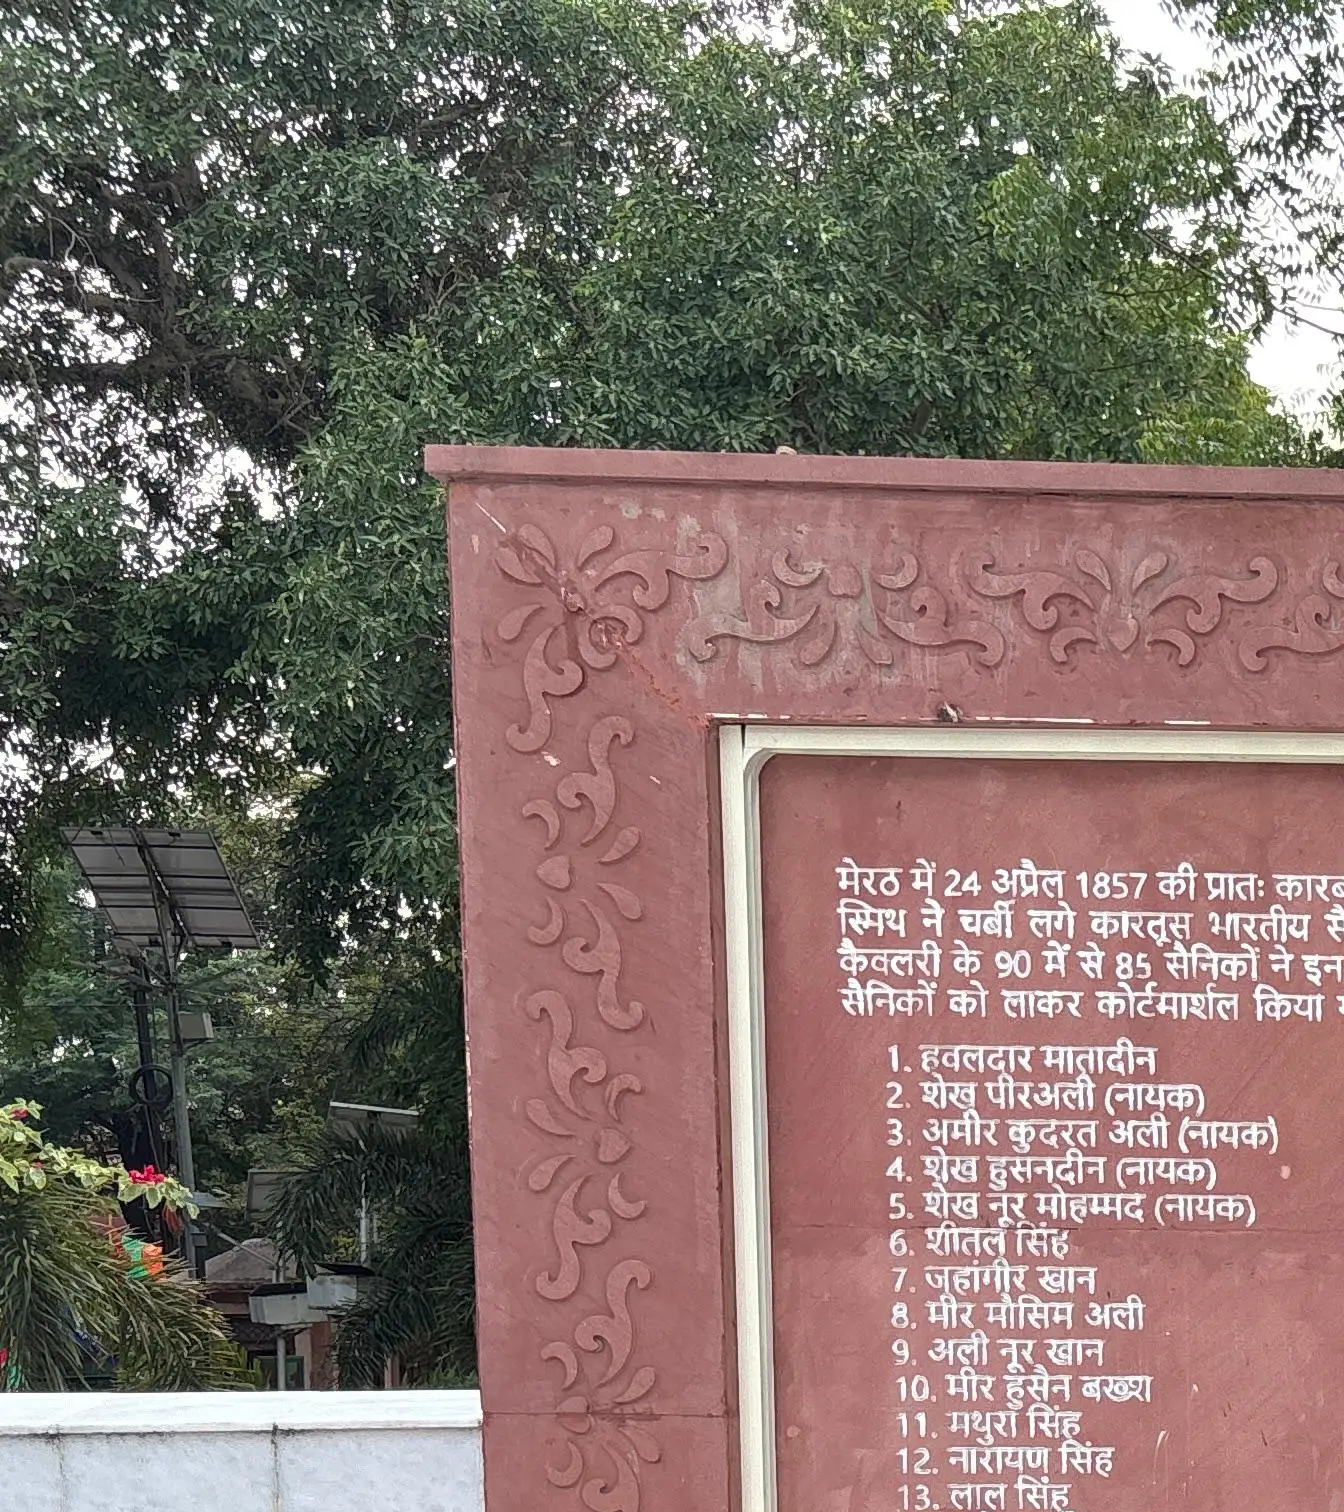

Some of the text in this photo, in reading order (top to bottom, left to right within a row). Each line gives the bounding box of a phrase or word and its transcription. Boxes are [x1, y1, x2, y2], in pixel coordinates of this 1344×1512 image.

[835, 857, 903, 896] मेरठ
[909, 858, 936, 903] में
[944, 869, 981, 896] 24
[992, 858, 1066, 898] अप्रैल
[1076, 872, 1147, 899] 1857
[1155, 862, 1198, 900] की
[836, 898, 908, 942] स्मिथ
[921, 898, 945, 937] ने
[1027, 901, 1077, 939] लगे
[1089, 911, 1194, 954] कारतूस
[1209, 904, 1311, 942] भारतीय
[888, 1037, 1158, 1079] 1. हवलदार मातादीन
[887, 1108, 1278, 1153] 3. अमीर कुदरत अली (नायक)
[892, 1267, 915, 1292] 7.
[1036, 1266, 1097, 1294] खान
[896, 1433, 1115, 1477] 12. नारायण सिंह
